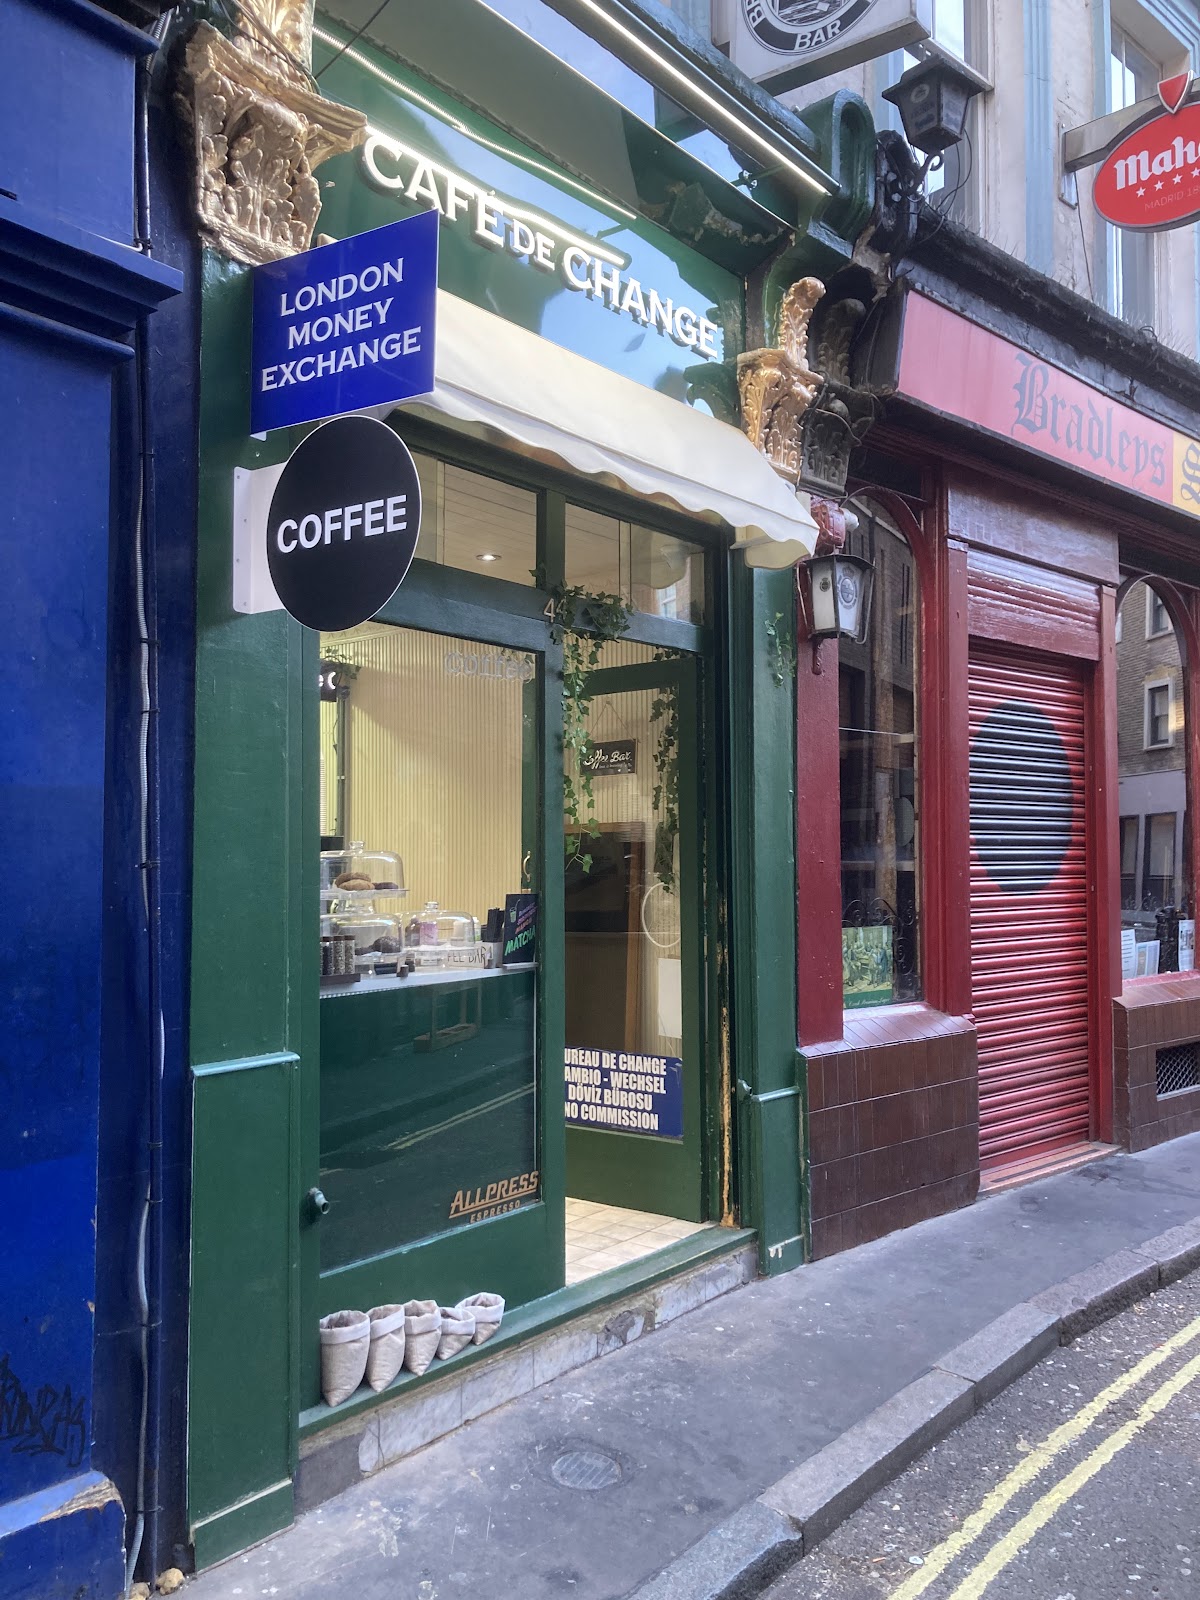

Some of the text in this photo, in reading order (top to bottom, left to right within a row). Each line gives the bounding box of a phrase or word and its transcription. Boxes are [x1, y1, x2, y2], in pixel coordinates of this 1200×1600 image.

[793, 19, 842, 51] BAR
[1113, 135, 1200, 191] Mah
[1144, 190, 1184, 212] MADRID
[280, 257, 404, 317] LONDON
[512, 218, 556, 272] DE
[562, 246, 718, 360] CHANGE
[288, 296, 395, 350] MONEY
[261, 326, 422, 392] EXCHANGE
[1010, 352, 1166, 490] Bradleys
[277, 494, 407, 553] COFFEE
[504, 924, 536, 957] MATCHA
[601, 1051, 617, 1070] DE
[618, 1053, 667, 1076] CHANGE
[610, 1071, 667, 1095] WECHSEL
[565, 1101, 579, 1119] NO
[580, 1103, 659, 1131] COMMISSION
[603, 1086, 653, 1111] BÜROSU
[449, 1170, 539, 1217] ALLPRESS
[469, 1200, 521, 1224] ESPRESSO
